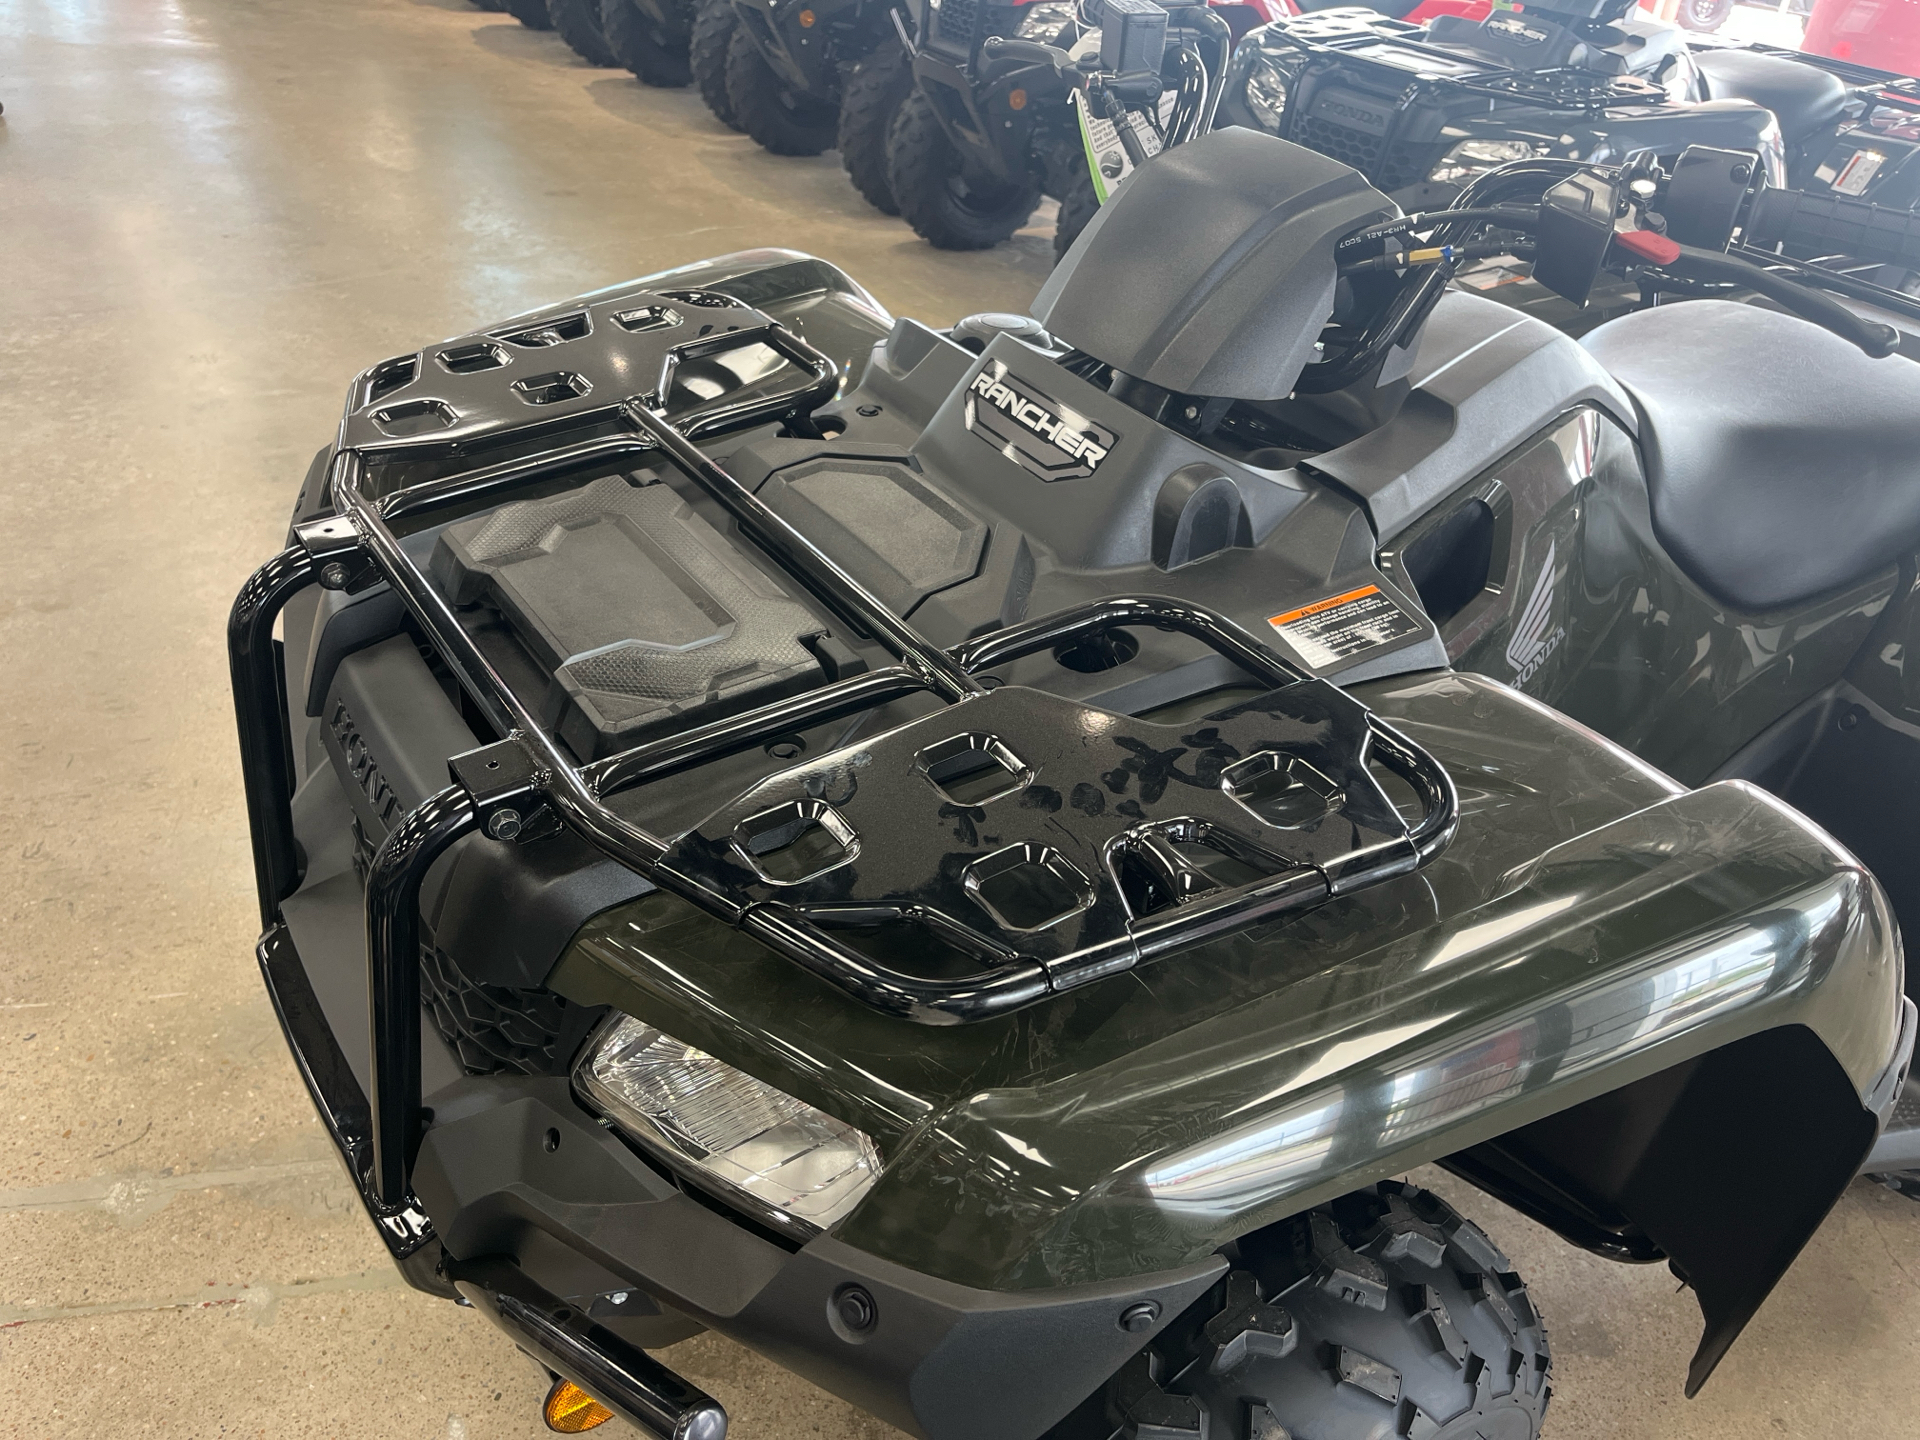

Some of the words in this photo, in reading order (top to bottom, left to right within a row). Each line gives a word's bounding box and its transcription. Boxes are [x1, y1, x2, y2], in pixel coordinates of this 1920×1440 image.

[1366, 224, 1406, 240] HR3-A21
[970, 372, 1107, 469] RANCHER
[1310, 598, 1344, 612] WARNING
[1317, 615, 1348, 627] performance
[1320, 614, 1339, 622] change
[1509, 626, 1566, 690] HONDA
[329, 698, 407, 836] HOND
